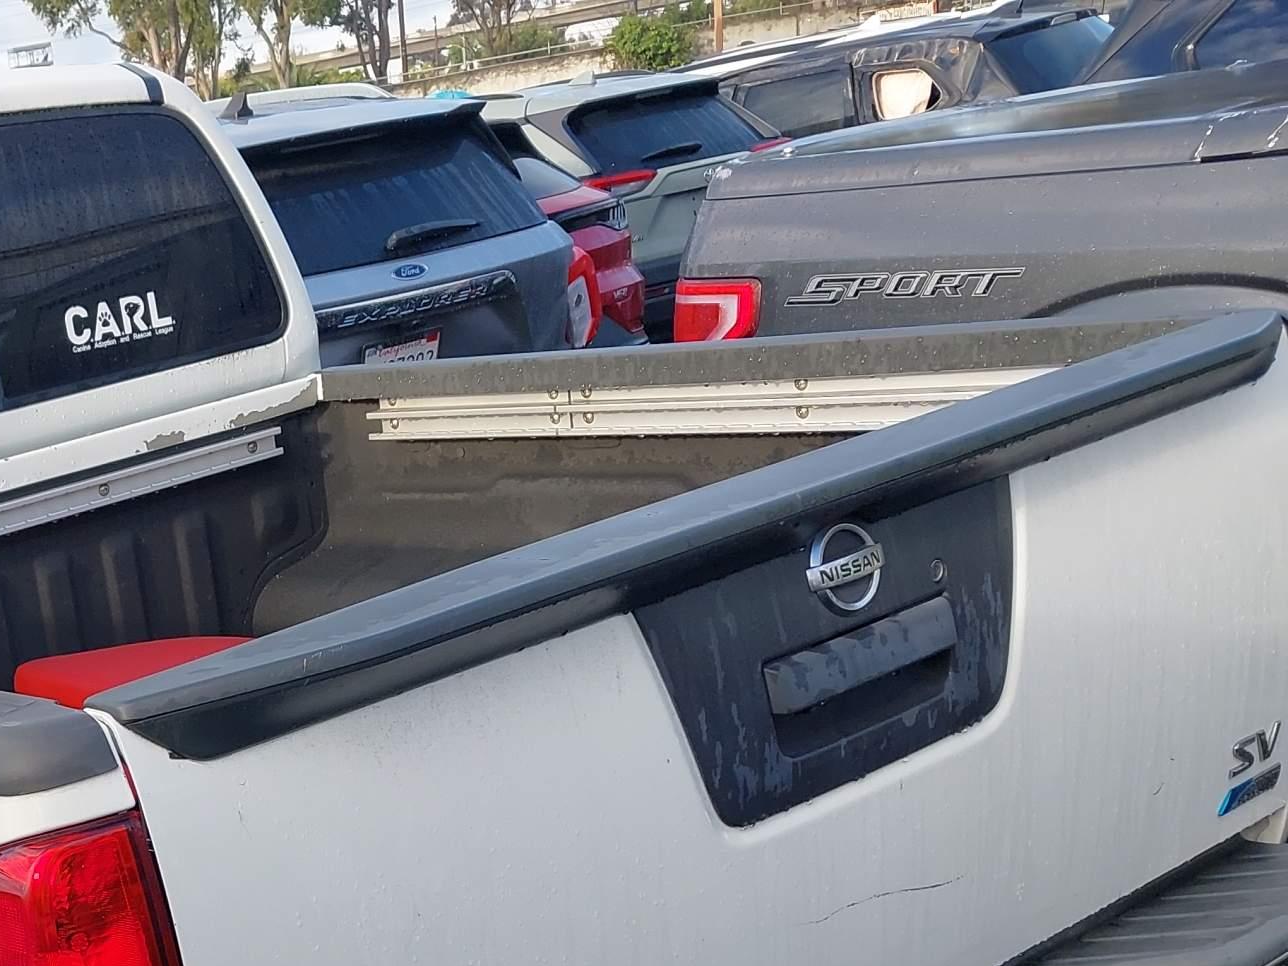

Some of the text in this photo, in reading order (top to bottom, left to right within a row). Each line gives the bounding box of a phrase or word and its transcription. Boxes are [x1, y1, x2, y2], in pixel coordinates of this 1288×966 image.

[337, 284, 488, 328] EXPLORER
[784, 267, 1025, 307] SPORT
[72, 326, 174, 353] Canine Adoption and Rescue League
[818, 549, 881, 585] NISSAN
[1228, 720, 1281, 780] SV
